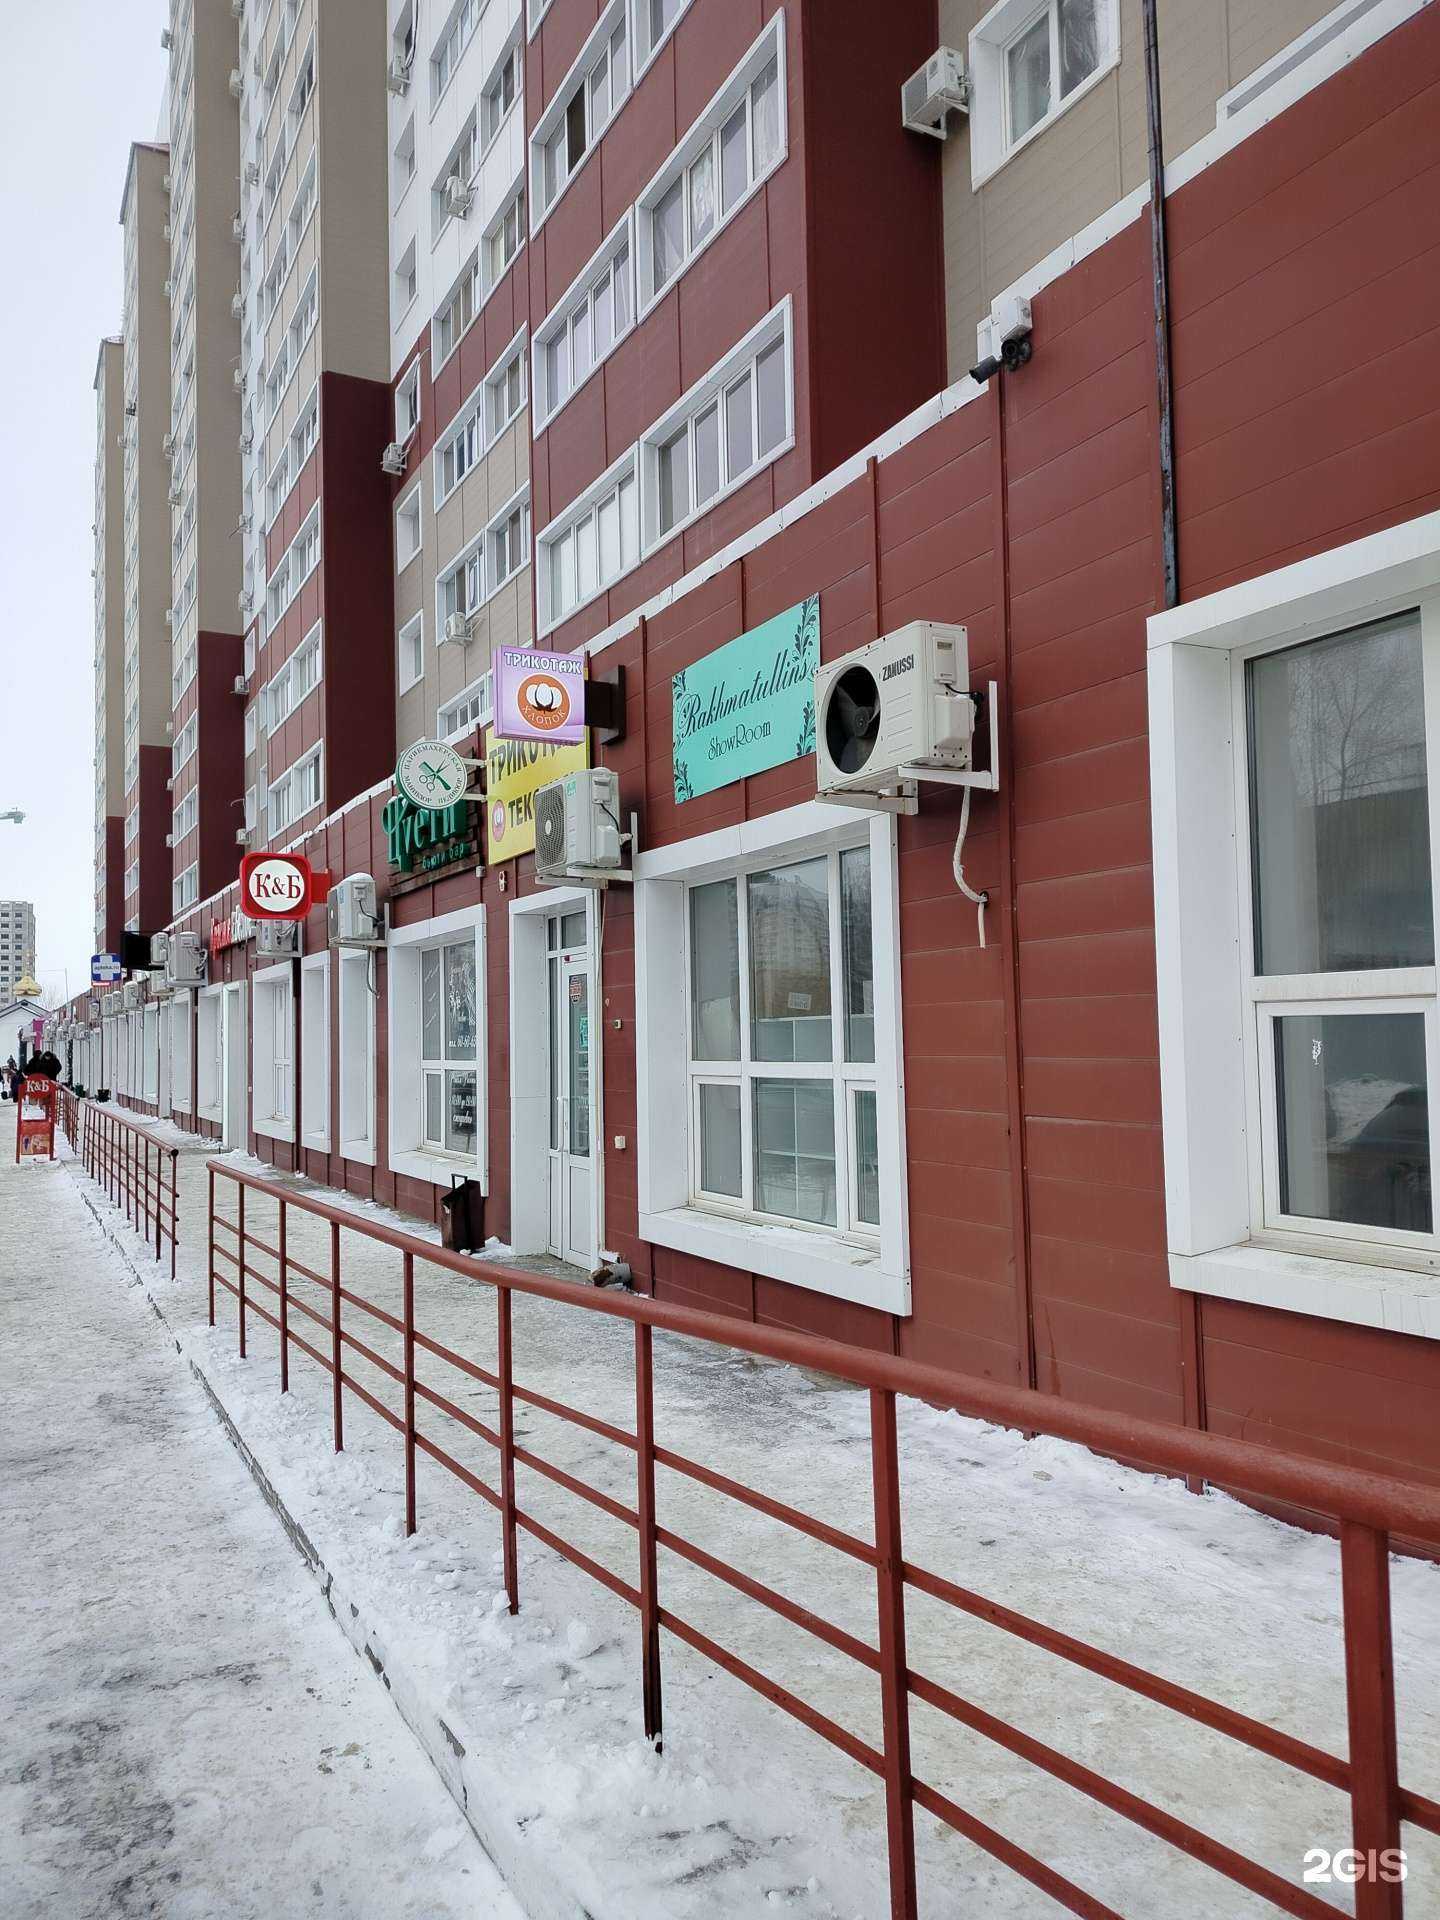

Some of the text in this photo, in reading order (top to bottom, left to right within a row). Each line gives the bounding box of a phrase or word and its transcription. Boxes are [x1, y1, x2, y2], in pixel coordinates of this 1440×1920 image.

[504, 652, 582, 674] ТРИКОТАЖ
[882, 654, 914, 681] ZANUSSI
[678, 649, 808, 738] Rakhmatullins
[523, 705, 567, 726] ХЛОПОК
[254, 873, 301, 899] К&Б
